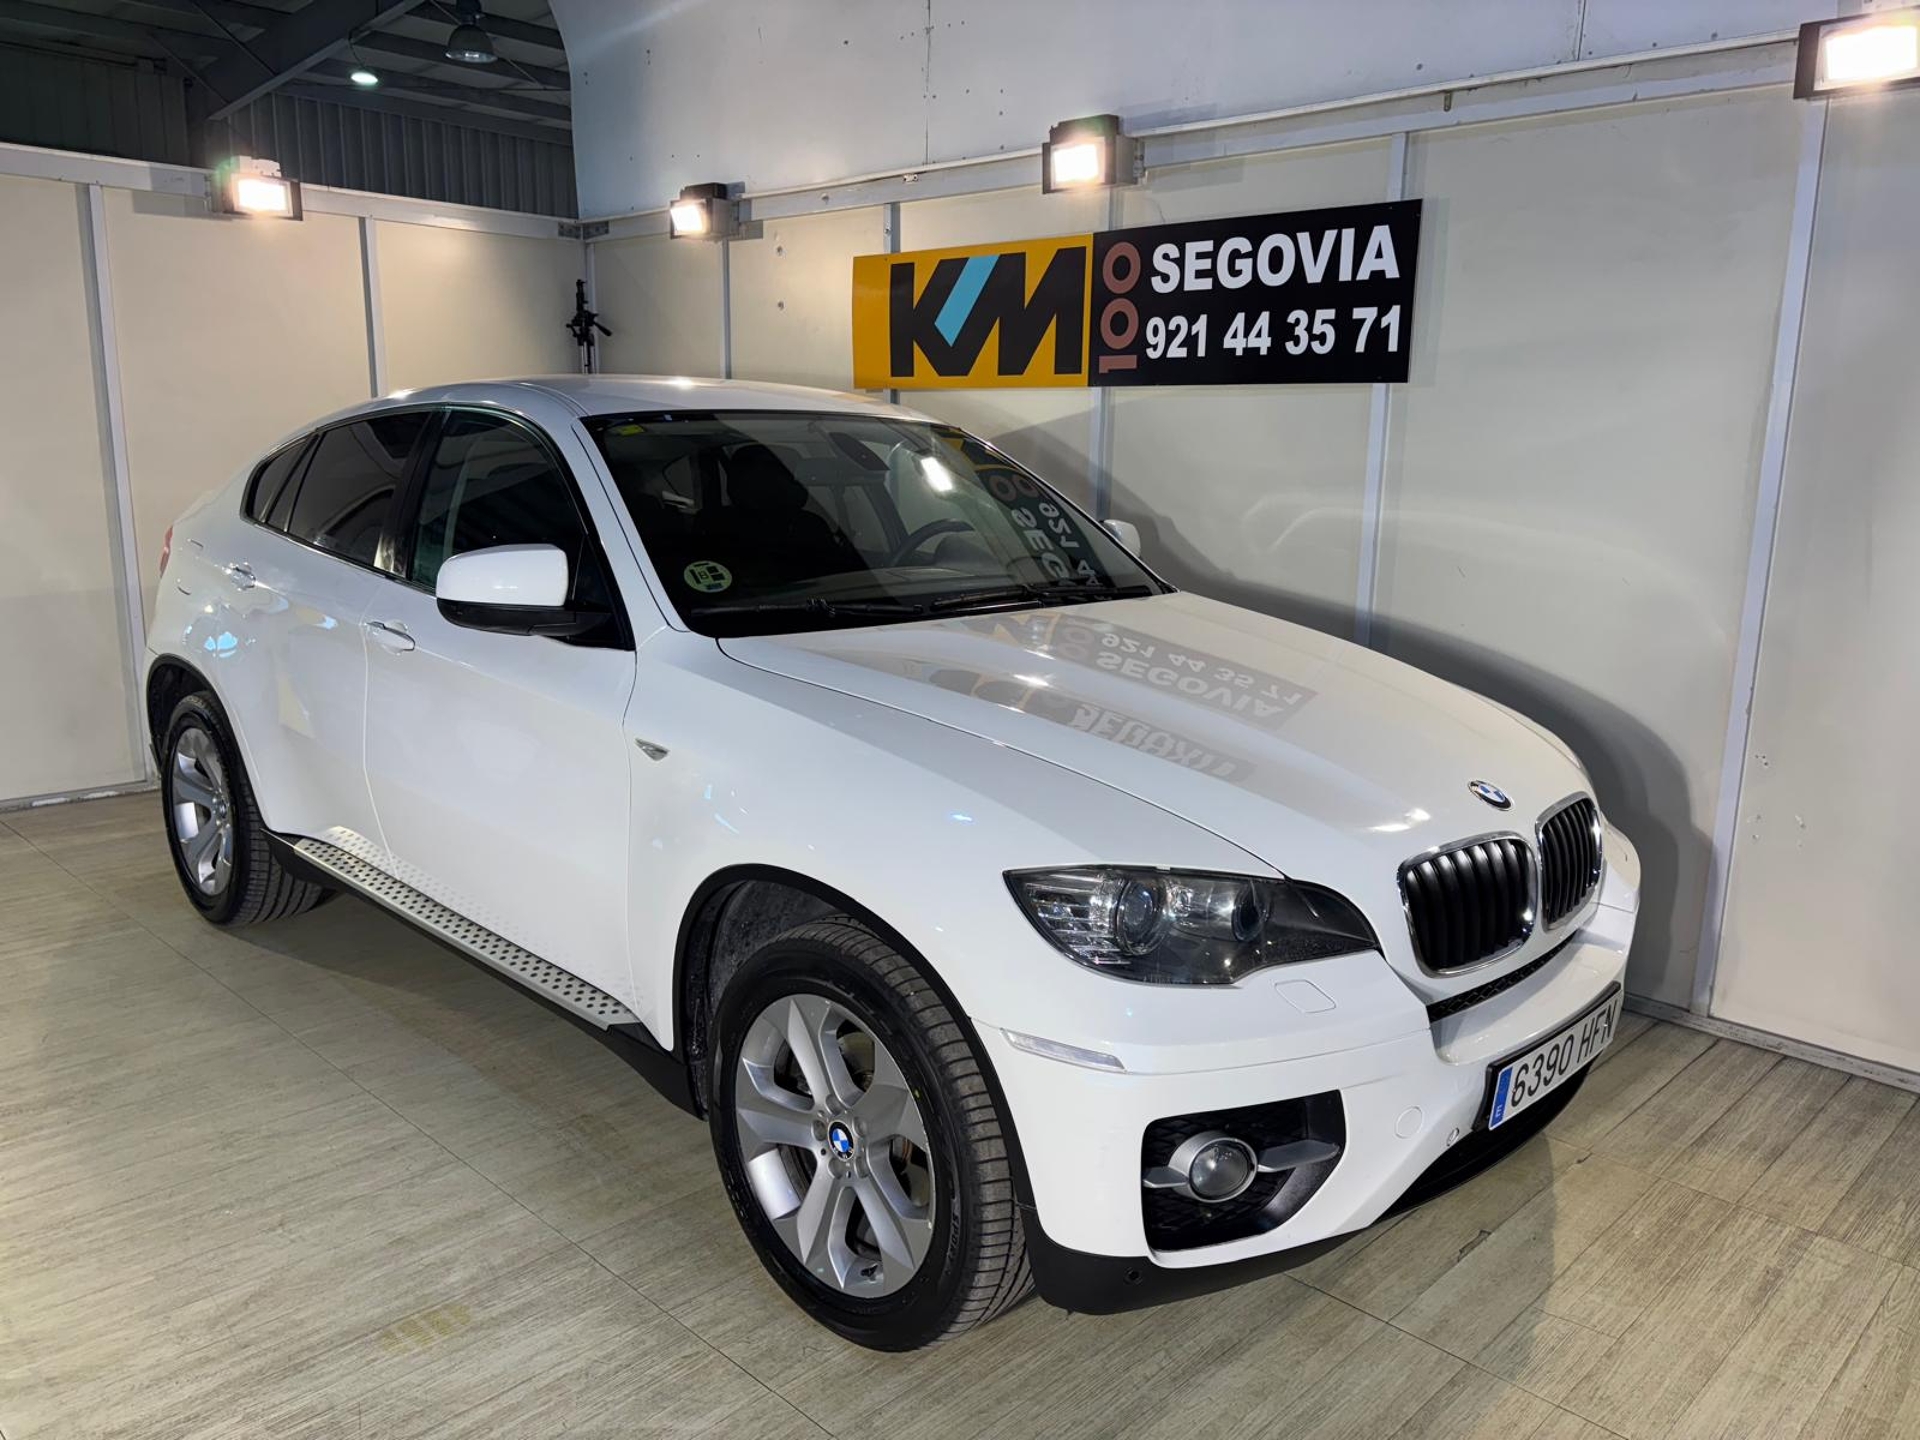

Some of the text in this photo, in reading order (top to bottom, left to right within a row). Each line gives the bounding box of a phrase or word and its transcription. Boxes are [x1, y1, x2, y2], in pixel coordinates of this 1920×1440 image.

[890, 246, 1087, 378] KM
[1098, 241, 1141, 374] 100
[1151, 224, 1400, 294] SEGOVIA
[1145, 304, 1401, 360] 921 44 35 71
[1511, 999, 1619, 1107] 6390 HFN
